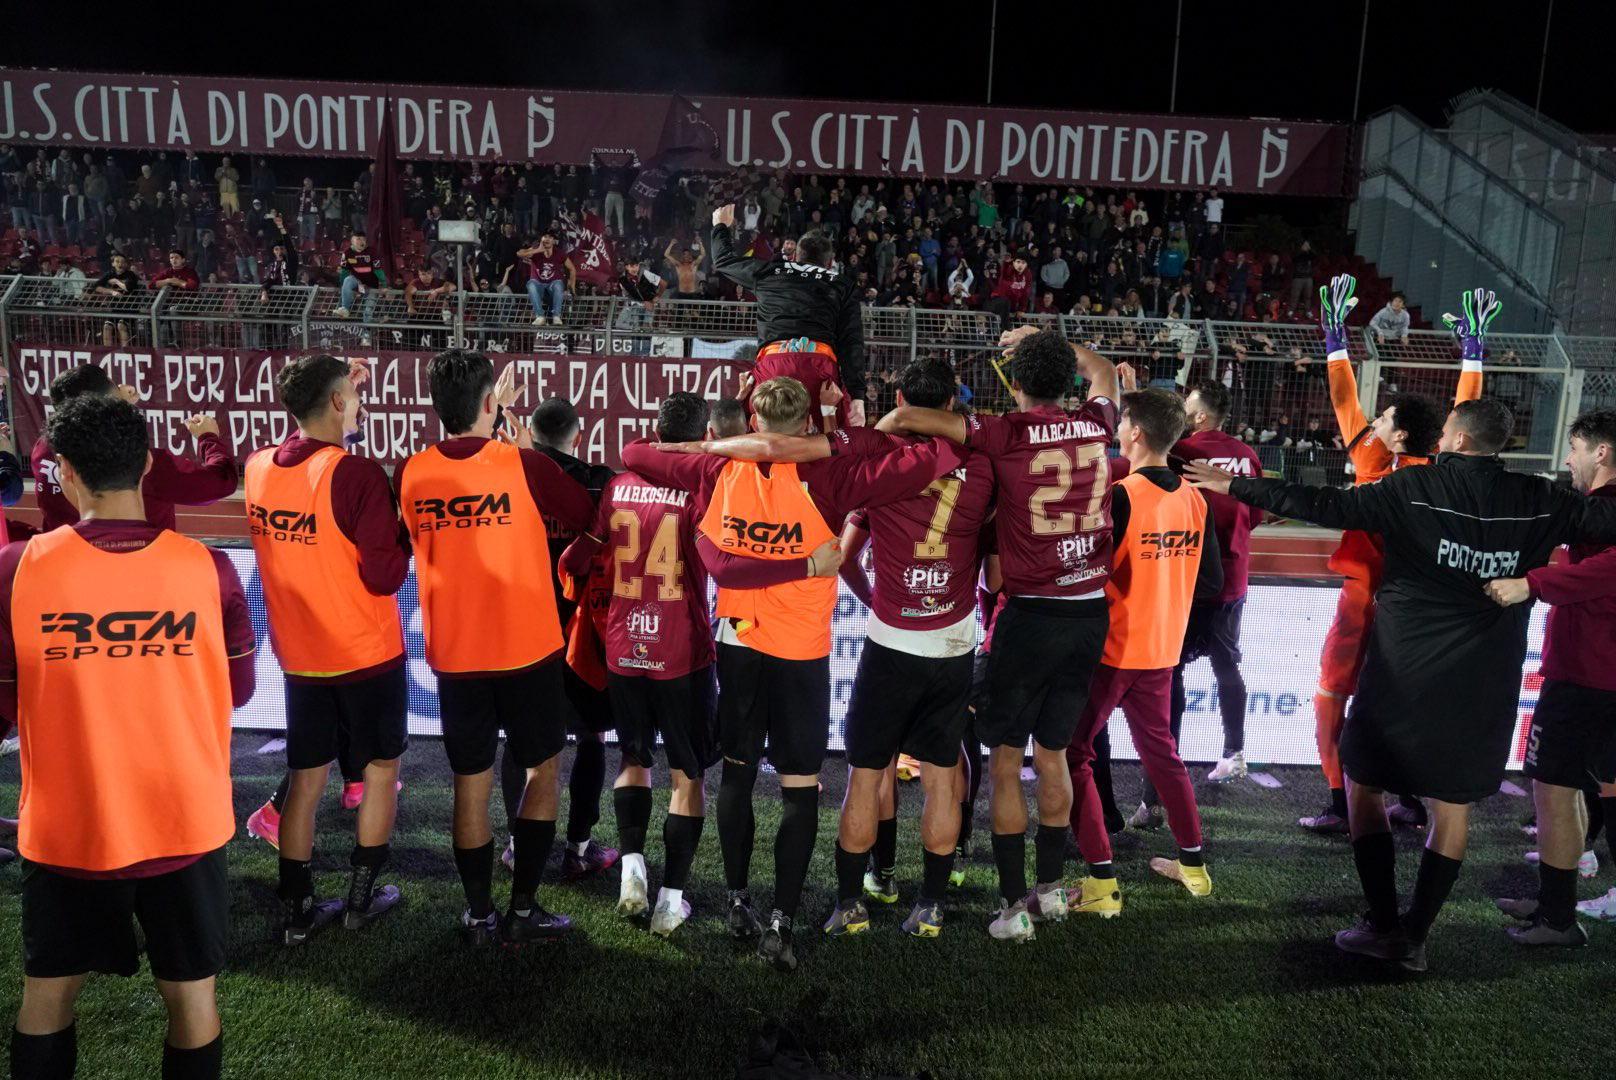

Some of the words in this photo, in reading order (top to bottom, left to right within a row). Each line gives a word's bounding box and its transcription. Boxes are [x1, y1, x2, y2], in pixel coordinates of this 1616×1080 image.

[208, 90, 248, 147] DI
[944, 119, 985, 175] DI
[1001, 121, 1233, 187] PONTEDERA
[164, 355, 224, 403] PER
[235, 355, 274, 403] LA
[569, 361, 607, 409] DA
[612, 485, 690, 508] MARKOSIAN
[1029, 442, 1108, 535] 27
[250, 503, 317, 534] RGM
[414, 492, 511, 519] RGM
[723, 515, 803, 544] RGM
[1141, 530, 1200, 550] RGM
[610, 509, 685, 602] 24
[41, 611, 196, 643] RGM
